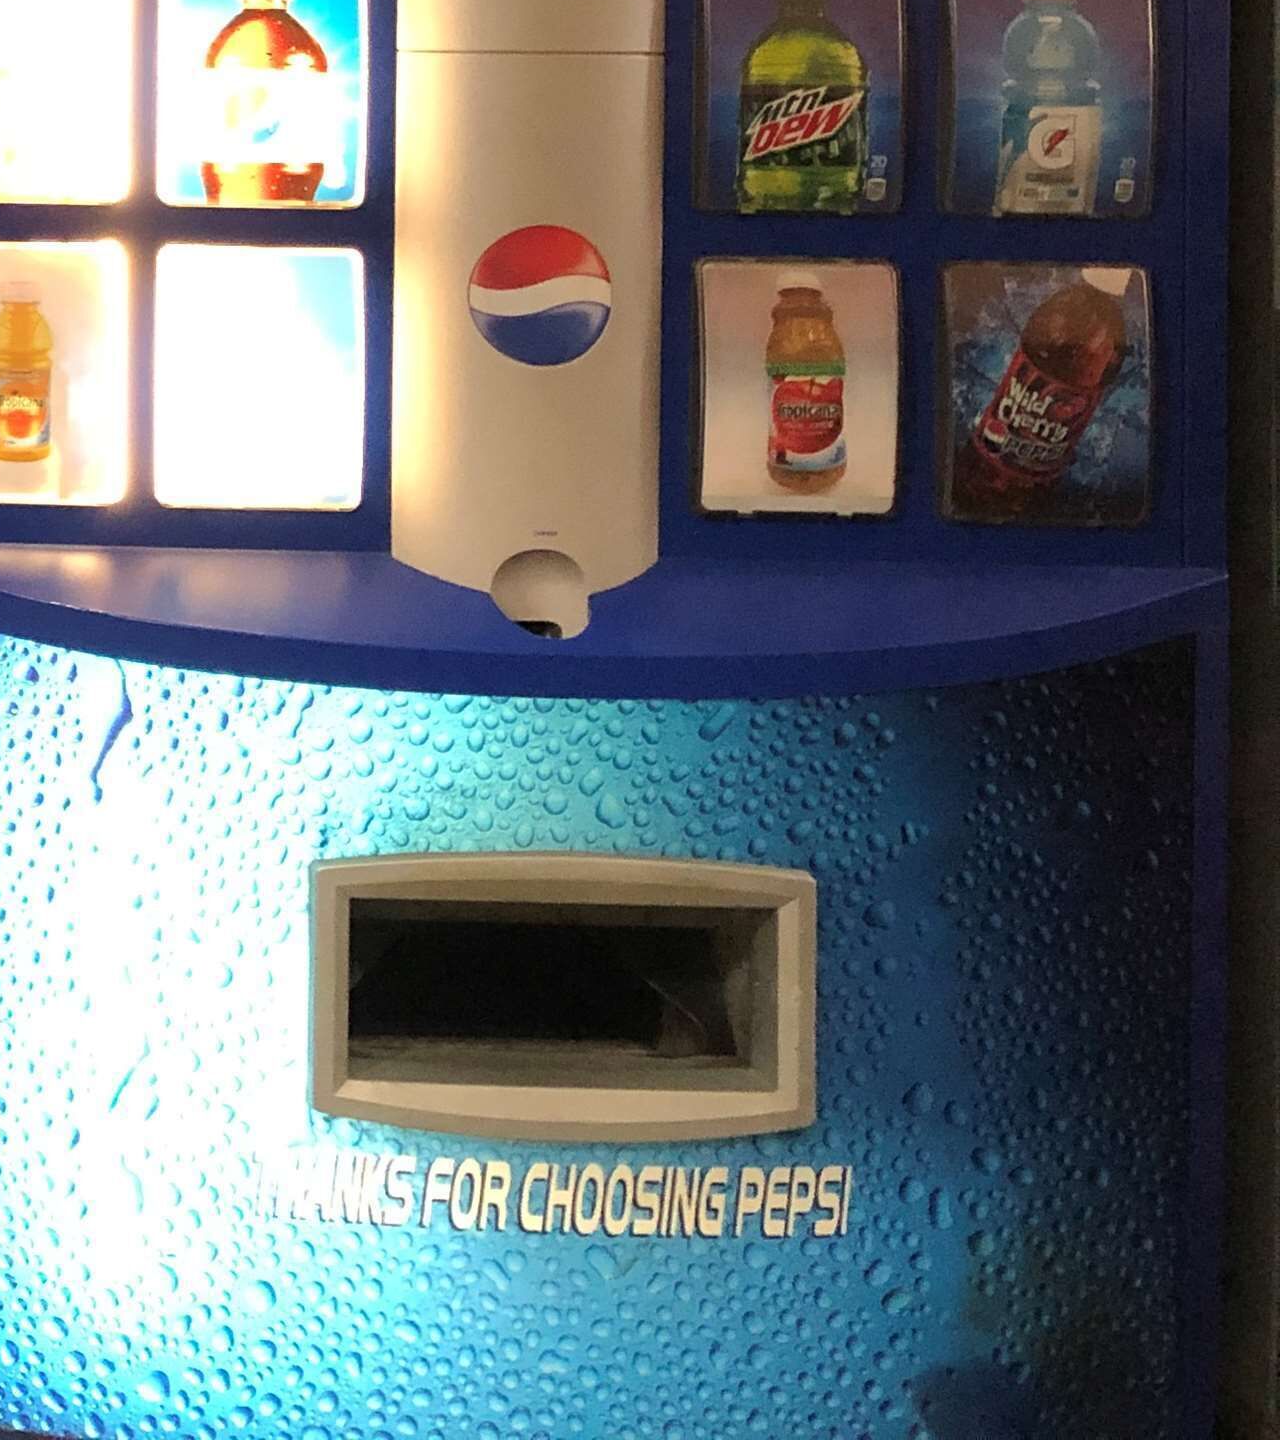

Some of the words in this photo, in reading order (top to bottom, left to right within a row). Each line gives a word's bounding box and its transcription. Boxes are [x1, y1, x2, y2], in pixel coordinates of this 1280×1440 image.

[775, 401, 842, 422] Tropicana
[996, 394, 1070, 444] Cherry
[1007, 376, 1052, 418] Wild
[254, 1152, 418, 1228] THANKS
[423, 1157, 512, 1232] FOR
[517, 1160, 730, 1237] CHOOSING
[734, 1163, 854, 1238] PEPSI
